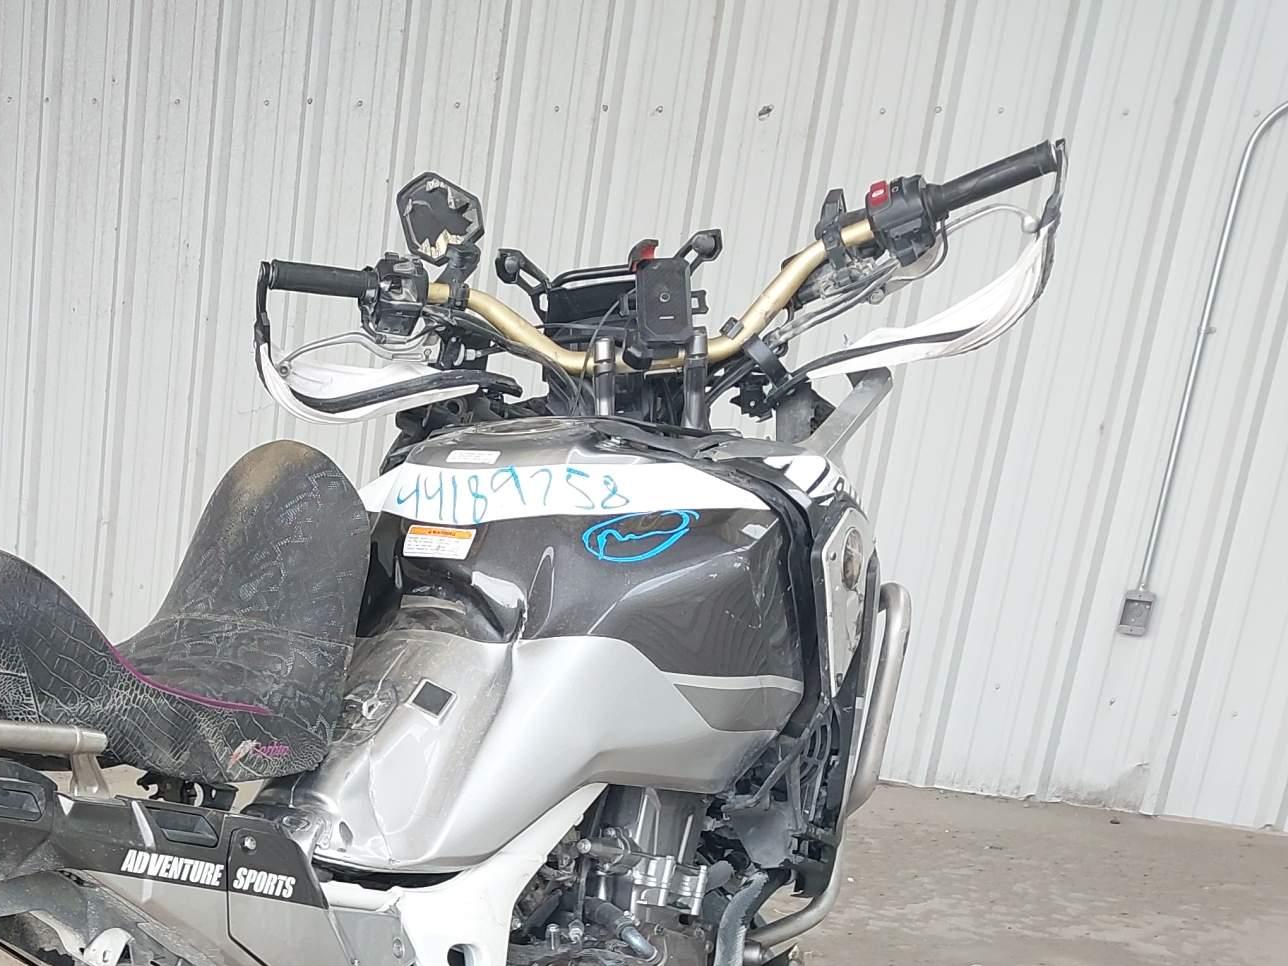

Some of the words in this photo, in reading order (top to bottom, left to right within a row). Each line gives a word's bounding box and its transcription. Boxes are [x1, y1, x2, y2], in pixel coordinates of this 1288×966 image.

[397, 465, 630, 524] 44189758
[120, 849, 224, 887] ADVENTURE
[232, 866, 296, 899] SPORTS
